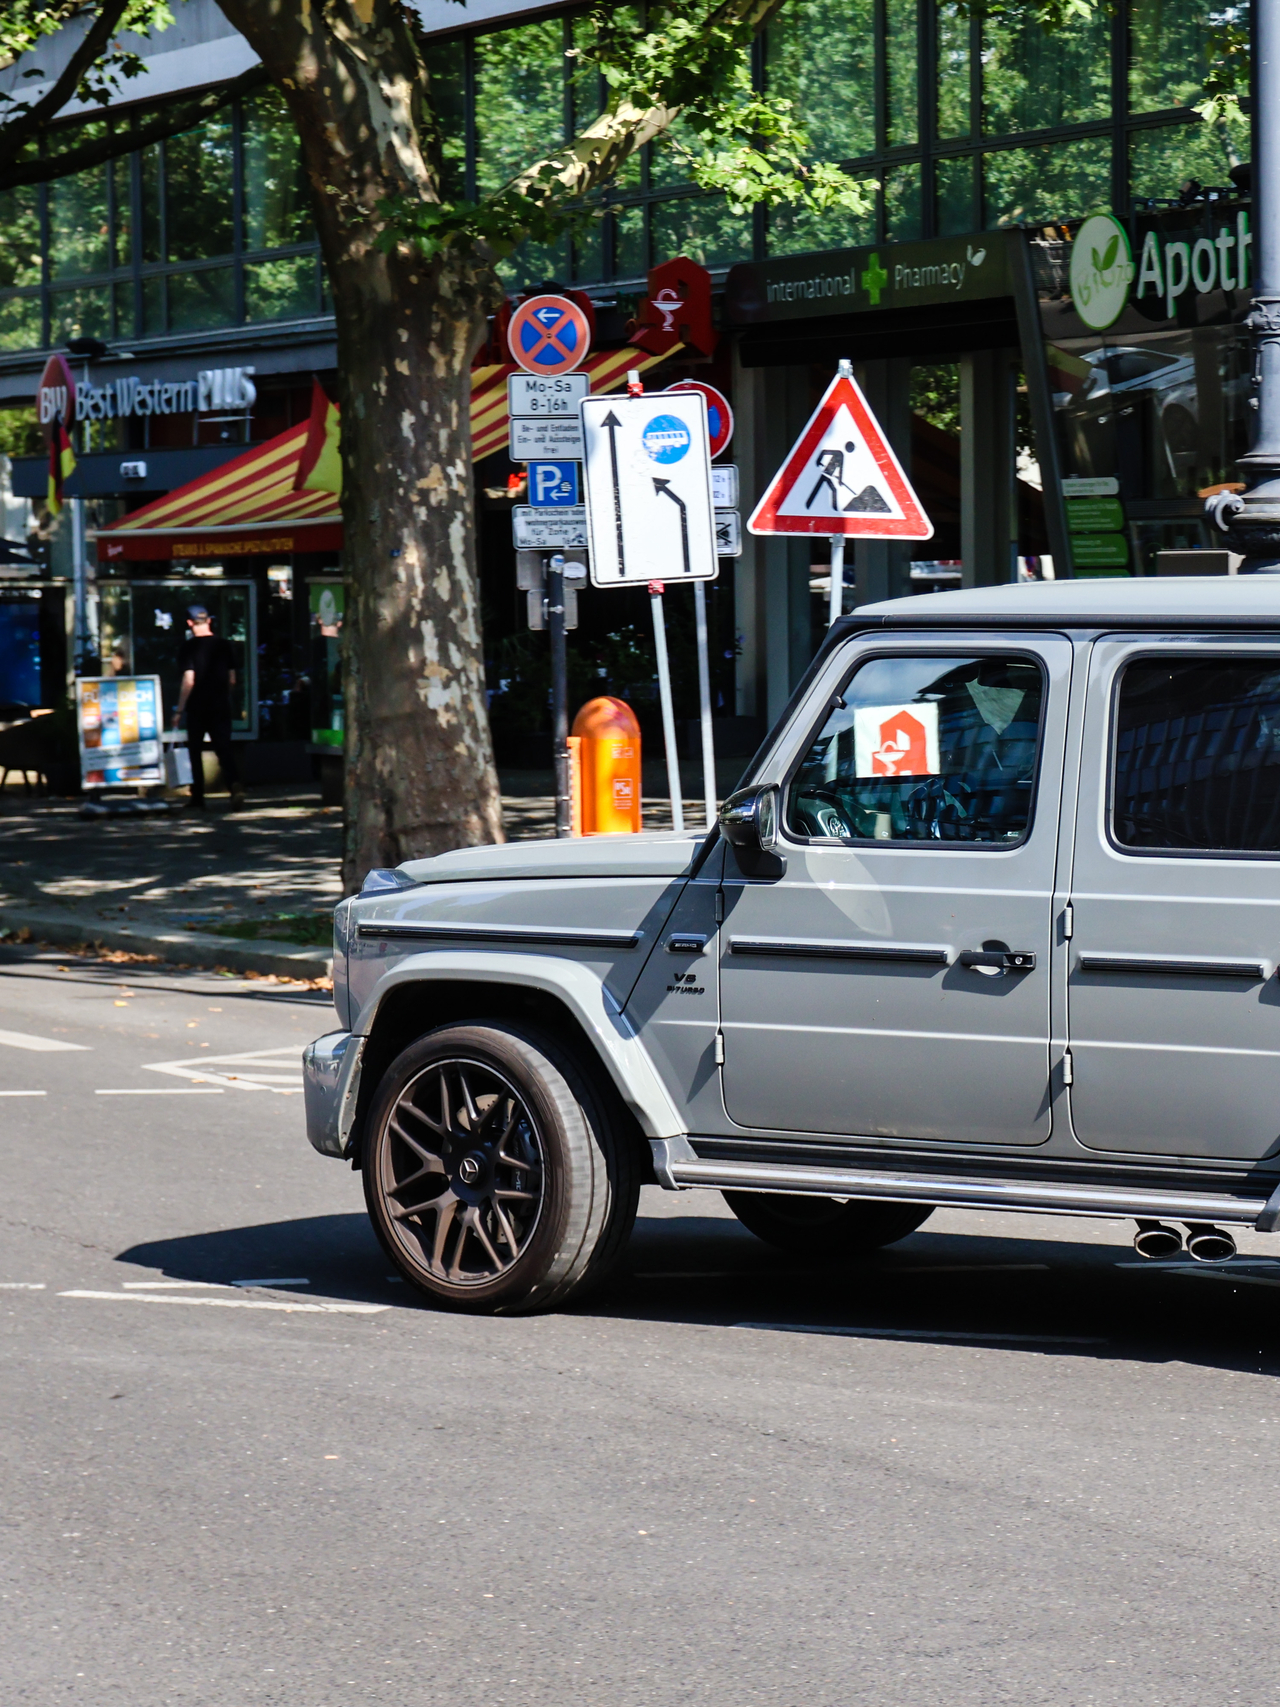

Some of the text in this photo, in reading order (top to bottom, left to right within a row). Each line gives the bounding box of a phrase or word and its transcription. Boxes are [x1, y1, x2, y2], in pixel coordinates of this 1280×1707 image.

[766, 262, 966, 303] international Pharmacy
[75, 382, 114, 421] Best
[115, 376, 198, 417] Western
[525, 380, 572, 392] Mo-Sa
[530, 398, 568, 411] 8-16h
